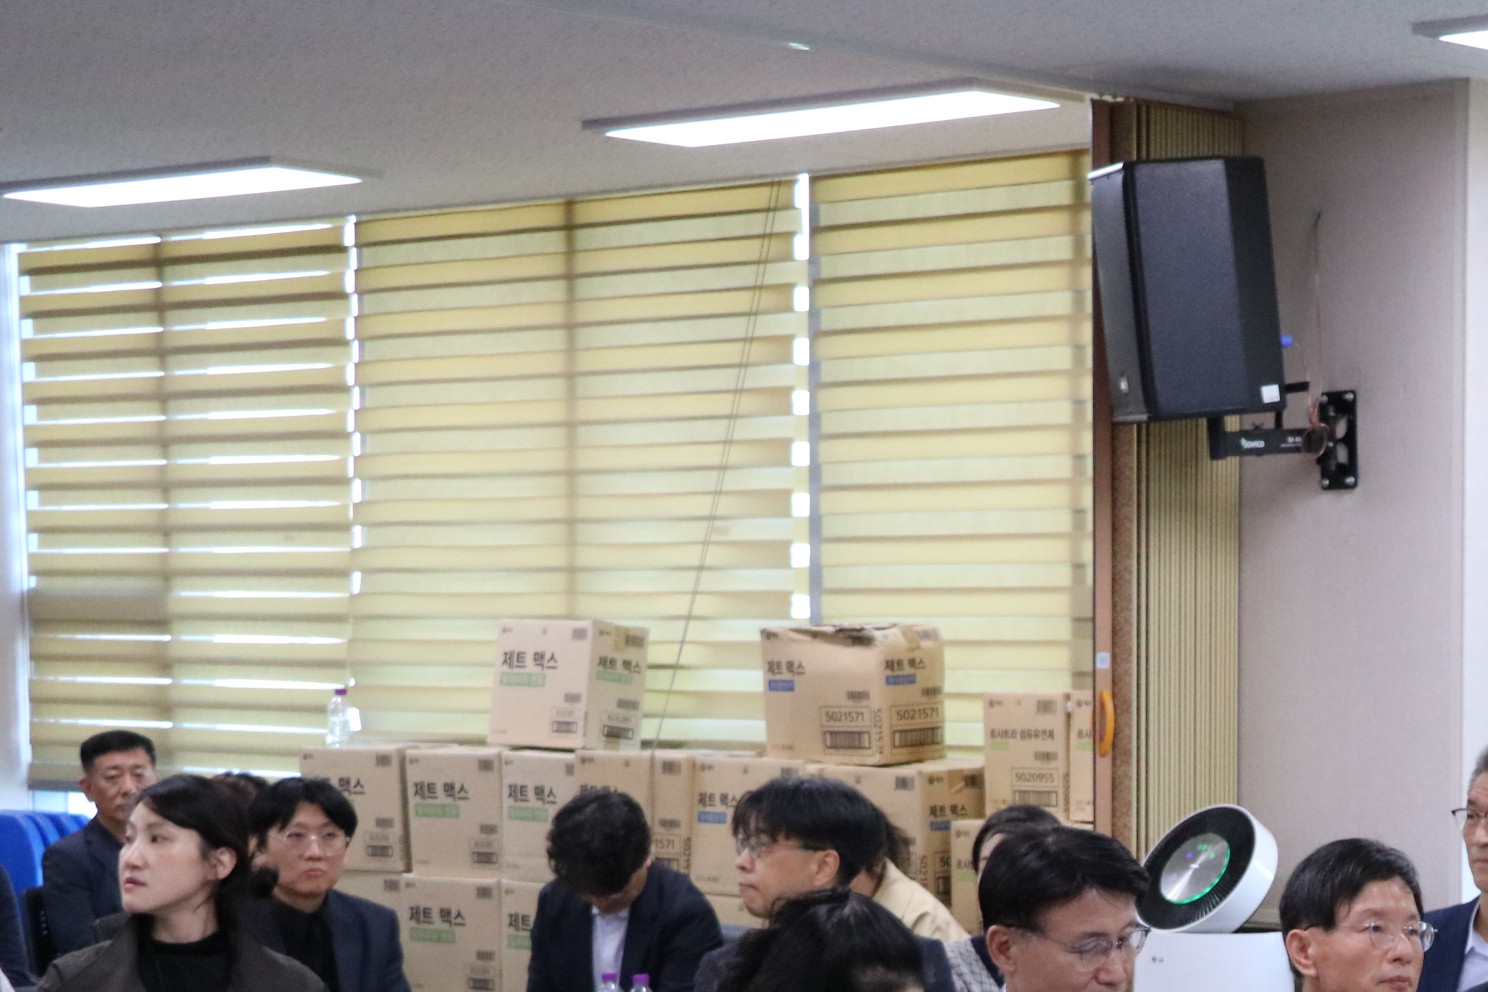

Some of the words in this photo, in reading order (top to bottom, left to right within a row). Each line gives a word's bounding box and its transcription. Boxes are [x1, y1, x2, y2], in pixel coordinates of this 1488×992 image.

[502, 650, 527, 669] 제트
[533, 651, 558, 671] 맥스
[597, 656, 617, 670] 제트
[622, 659, 641, 674] 맥스
[767, 660, 785, 675] 제트
[786, 660, 806, 676] 맥스
[885, 658, 905, 672] 제트
[908, 658, 927, 671] 맥스
[825, 710, 865, 723] 5021571
[896, 707, 940, 721] 5021571
[338, 776, 366, 795] 맥스
[1015, 771, 1055, 783] 5020955
[414, 781, 438, 800] 제트
[443, 782, 470, 801] 맥스
[508, 784, 529, 803] 제트
[534, 784, 557, 805] 맥스
[929, 806, 947, 819] 제트
[950, 805, 968, 817] 맥스
[654, 838, 675, 849] 1571
[409, 905, 434, 925] 제트
[439, 907, 467, 928] 맥스
[508, 912, 531, 932] 제트
